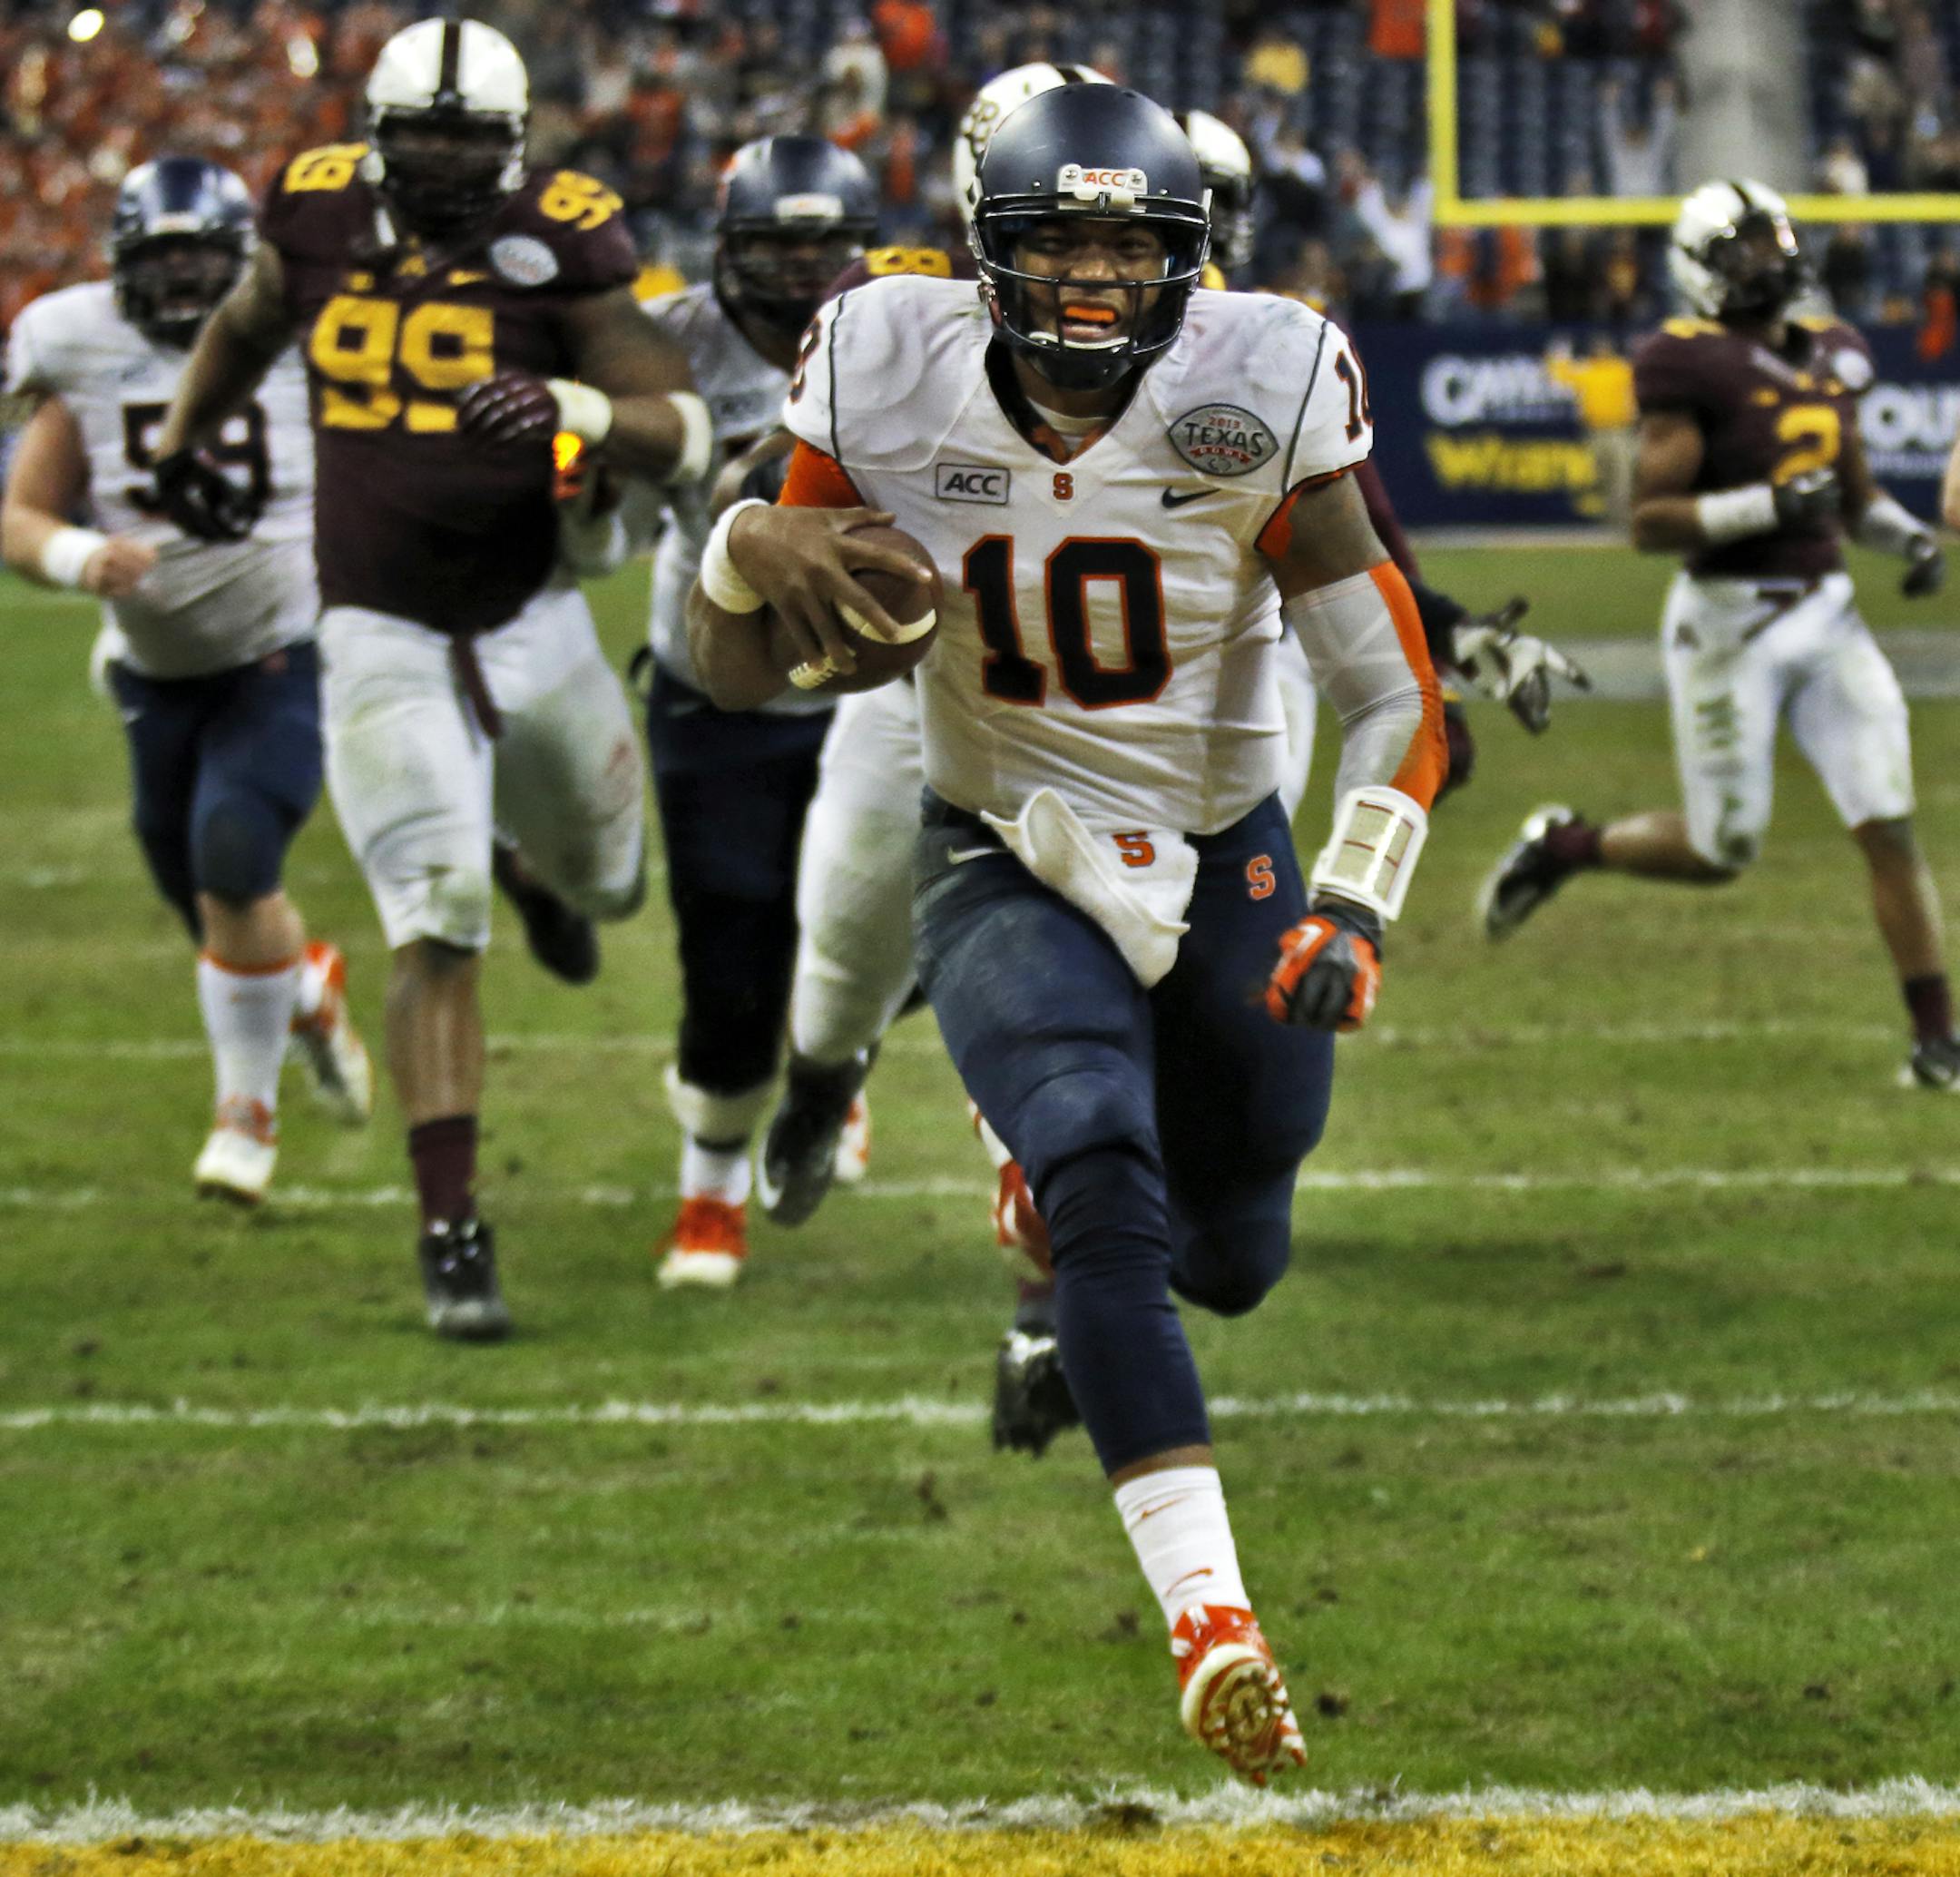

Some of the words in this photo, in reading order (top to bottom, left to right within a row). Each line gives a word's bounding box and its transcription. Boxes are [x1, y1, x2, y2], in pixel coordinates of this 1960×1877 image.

[1083, 171, 1125, 187] ACC
[309, 294, 495, 434] 99
[1335, 349, 1374, 444] 1
[1183, 422, 1264, 457] TEXAS
[1774, 404, 1841, 486] 2
[944, 472, 1001, 496] ACC
[1053, 471, 1073, 501] S
[963, 534, 1173, 712] 10
[1246, 853, 1277, 901] S
